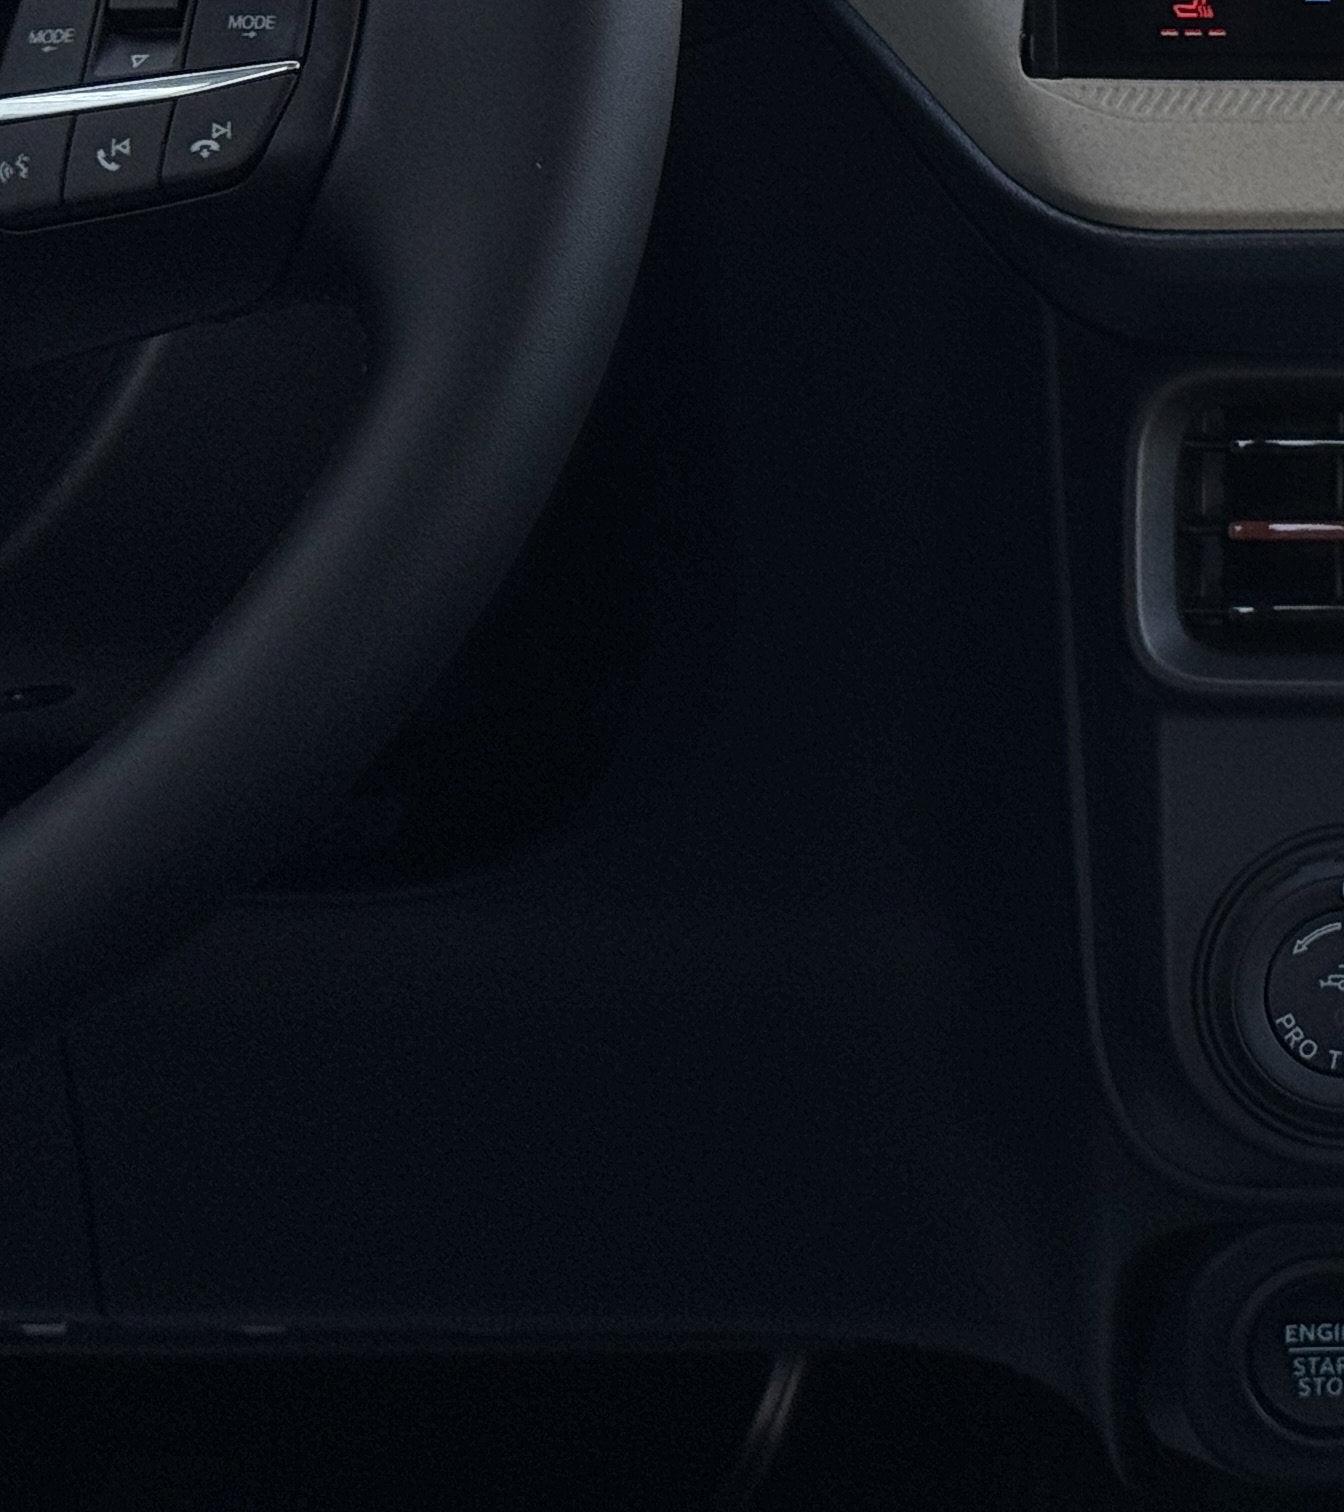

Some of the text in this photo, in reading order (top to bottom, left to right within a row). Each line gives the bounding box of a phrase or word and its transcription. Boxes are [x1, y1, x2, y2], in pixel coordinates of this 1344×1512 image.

[228, 14, 276, 30] MODE
[29, 28, 75, 44] MODE
[1275, 1012, 1318, 1060] PRO
